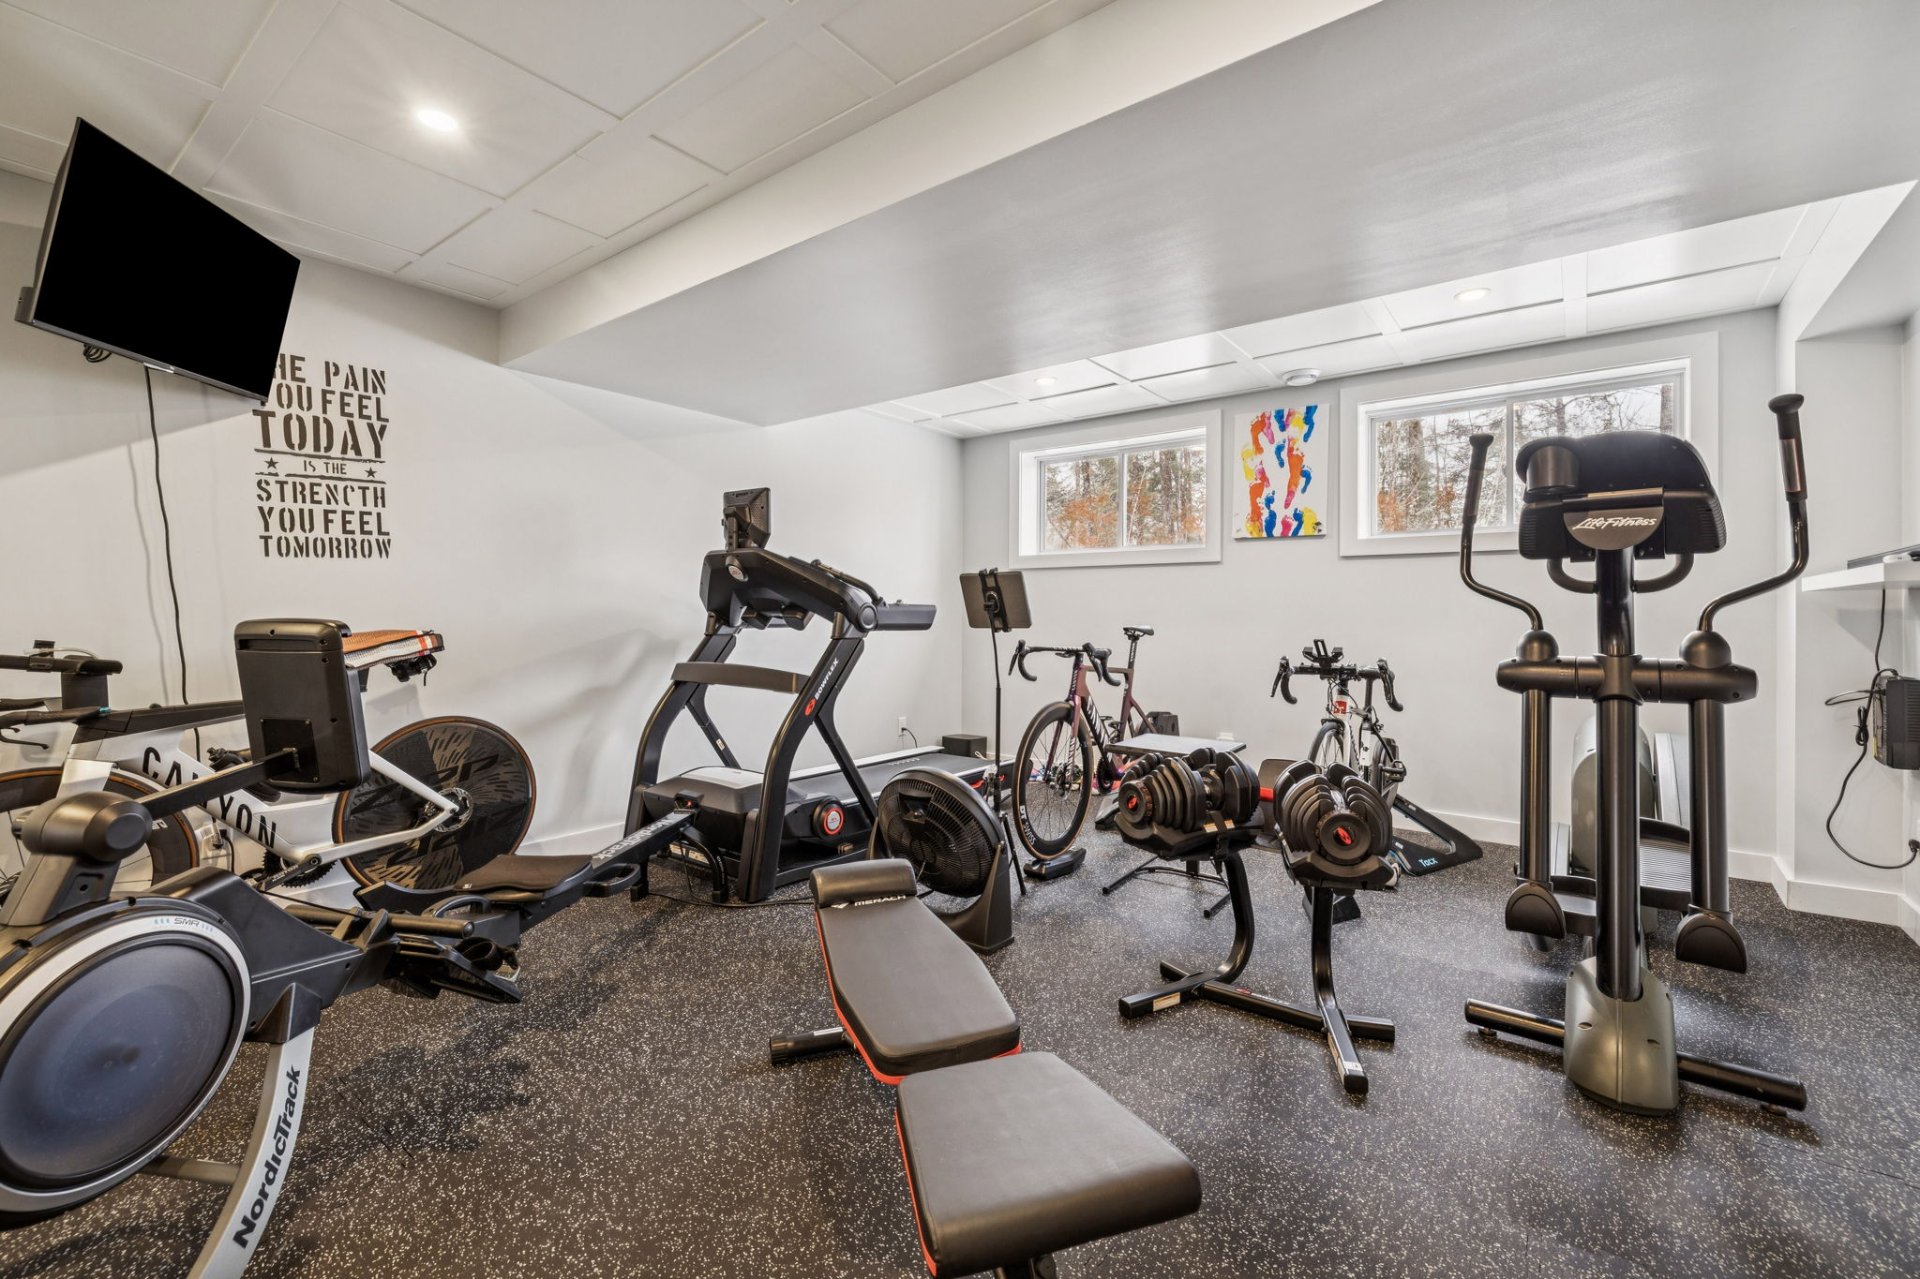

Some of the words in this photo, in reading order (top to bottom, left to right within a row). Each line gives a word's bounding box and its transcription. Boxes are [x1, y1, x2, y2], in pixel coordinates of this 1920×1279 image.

[272, 353, 306, 383] HE
[324, 361, 386, 395] PAIN
[275, 383, 313, 412] OU
[321, 388, 390, 423] FEEL
[252, 408, 388, 459] TODAY
[303, 459, 317, 473] IS
[323, 461, 348, 475] THE
[257, 505, 315, 534] YOU
[323, 508, 391, 537] FEEL
[259, 534, 392, 560] TOMORROW
[814, 657, 840, 701] BOWFLEX
[142, 745, 277, 850] CAYON
[173, 917, 200, 928] SMR
[232, 1064, 302, 1249] NordicTrack
